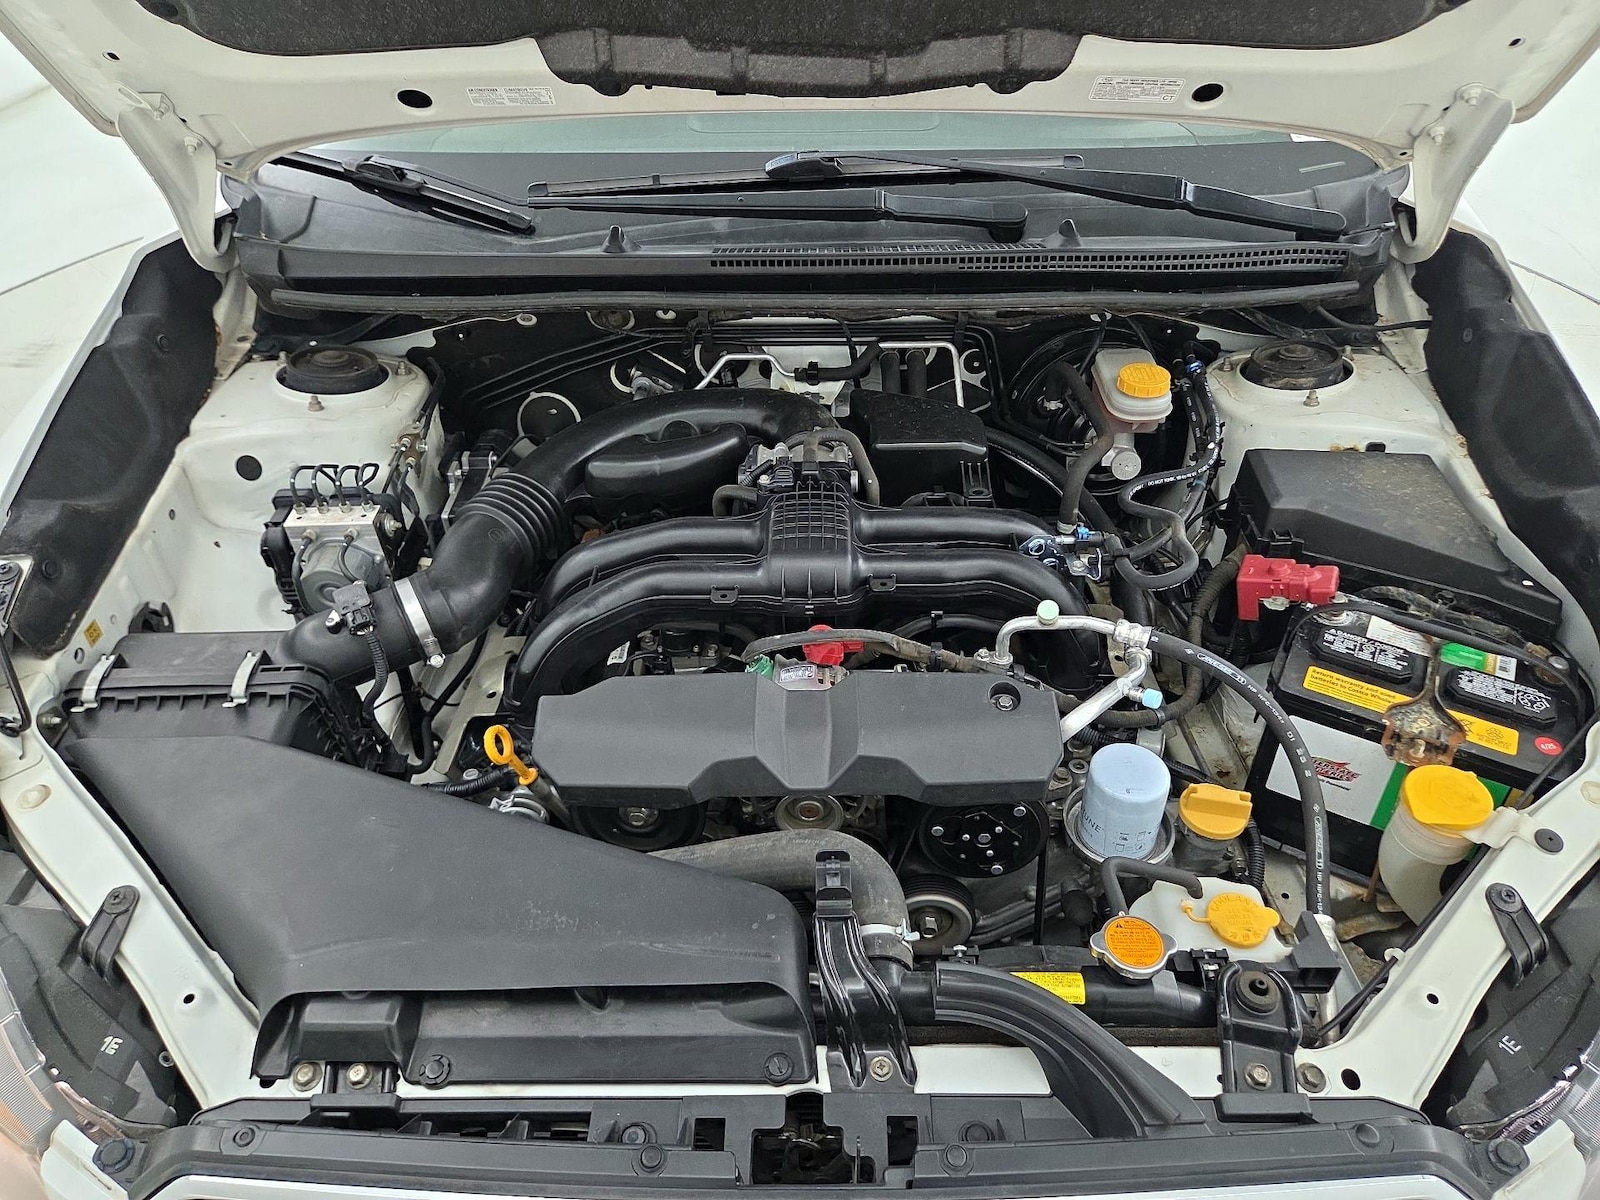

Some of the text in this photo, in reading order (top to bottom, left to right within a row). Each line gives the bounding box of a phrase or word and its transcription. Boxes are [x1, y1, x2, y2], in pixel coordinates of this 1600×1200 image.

[1310, 674, 1339, 688] batteries
[1348, 687, 1370, 697] Costco
[1312, 669, 1334, 680] Return
[1335, 675, 1364, 690] warranty
[1365, 684, 1379, 693] and
[100, 1035, 124, 1055] 1E
[1498, 1035, 1522, 1055] 1E
